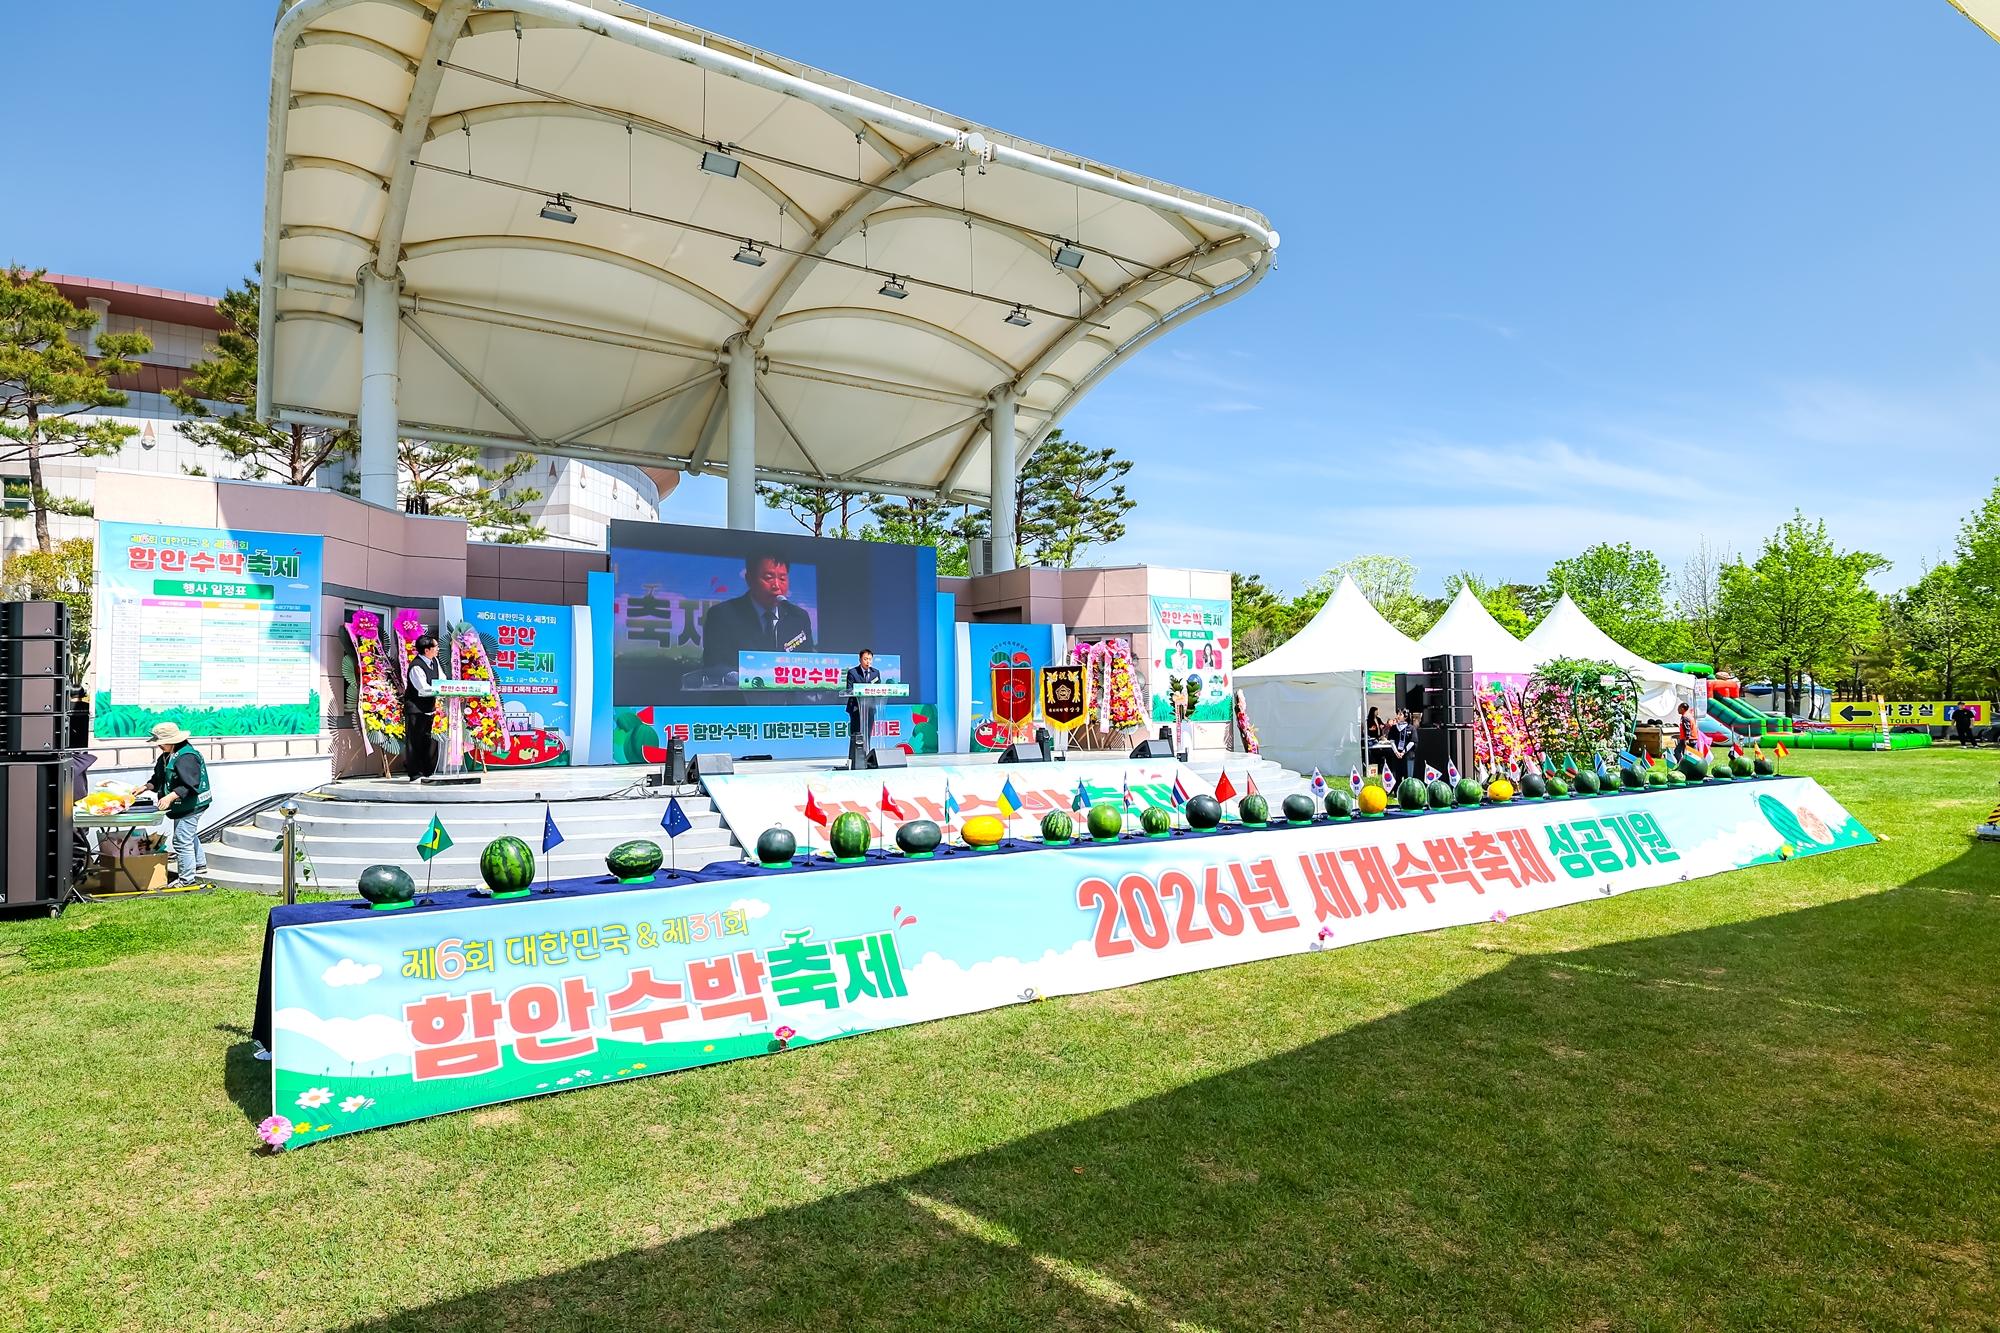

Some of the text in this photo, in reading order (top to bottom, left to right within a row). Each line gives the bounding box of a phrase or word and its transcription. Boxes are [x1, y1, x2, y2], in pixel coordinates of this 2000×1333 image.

[131, 534, 249, 551] 제6회 대한민국 & 제31회
[128, 546, 299, 578] 함안수박축제
[182, 582, 248, 596] 행사 일정표
[476, 611, 557, 625] 제6회 대한민국 & 제31회
[614, 583, 722, 649] 축제
[1161, 609, 1223, 627] 함안수박축제
[497, 625, 537, 647] 함안
[692, 723, 758, 741] 함안수박!
[763, 721, 831, 739] 대한민국을
[1078, 809, 1682, 959] 2026년 세계수박축제 성공기원
[401, 908, 750, 981] 제6회 대한민국 & 제31회
[404, 927, 909, 1082] 함안수박축제
